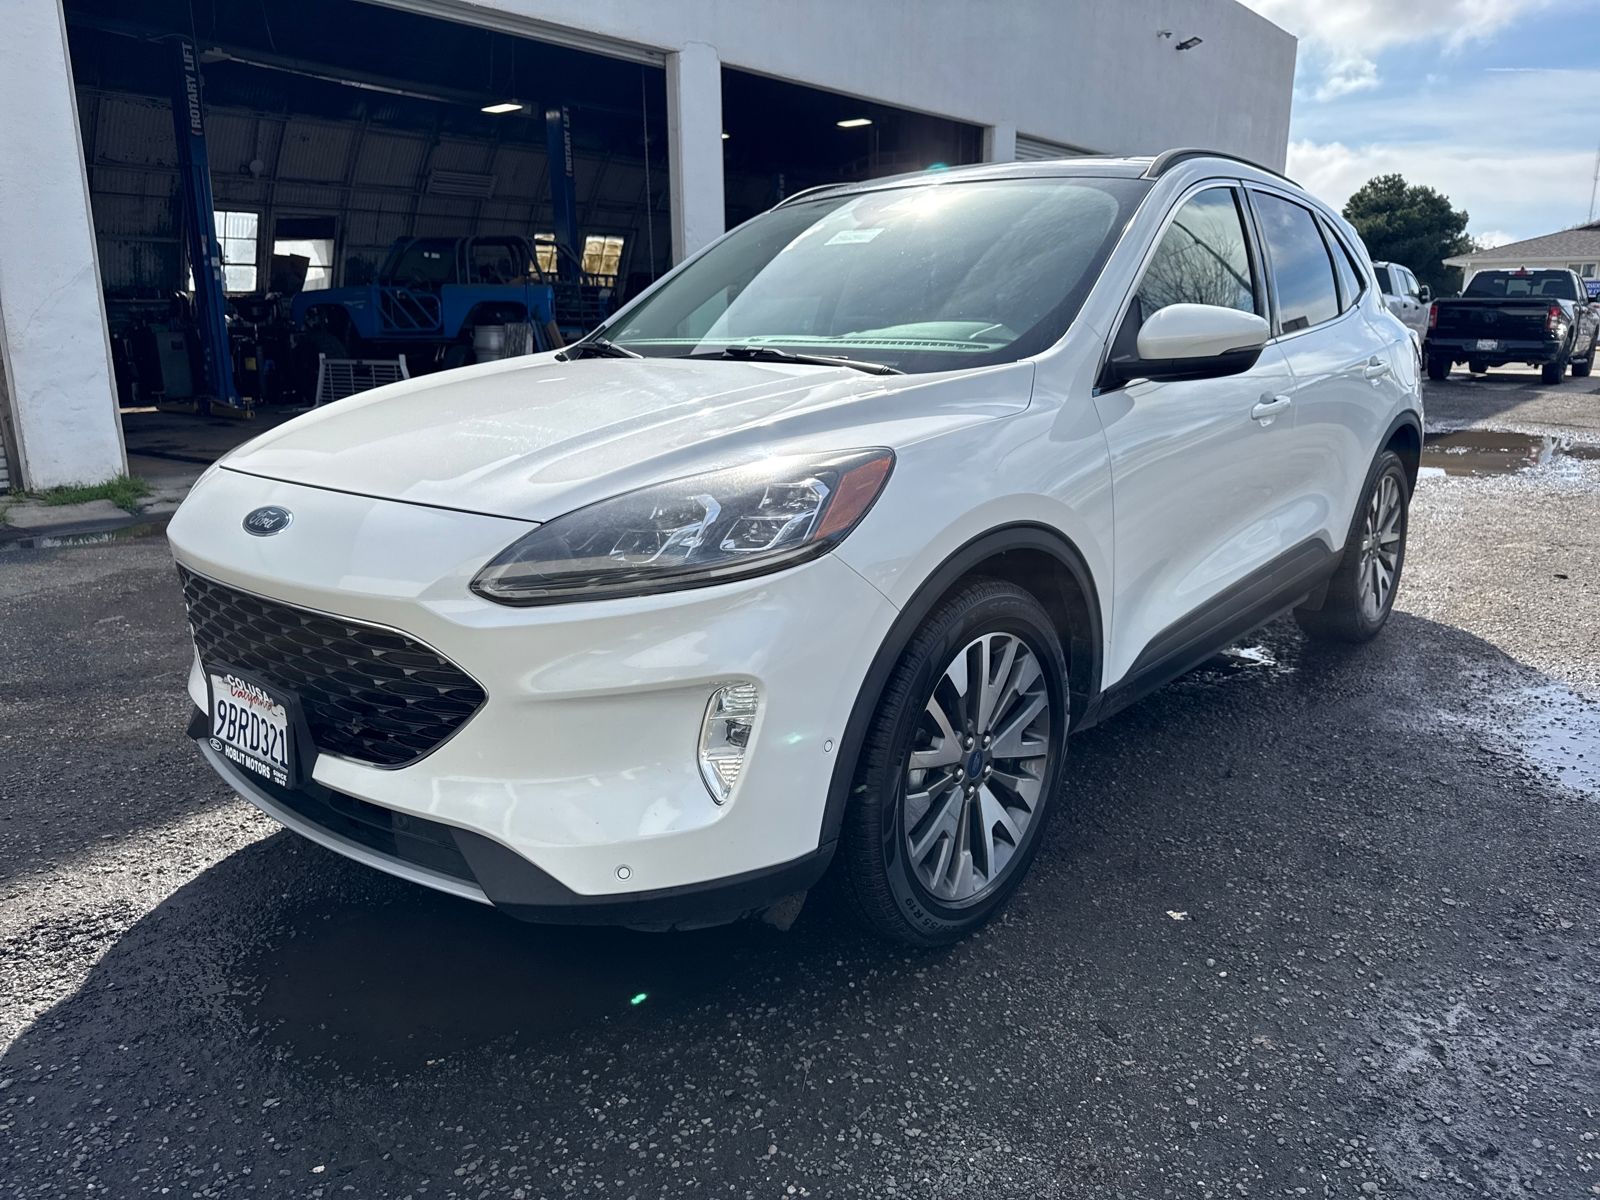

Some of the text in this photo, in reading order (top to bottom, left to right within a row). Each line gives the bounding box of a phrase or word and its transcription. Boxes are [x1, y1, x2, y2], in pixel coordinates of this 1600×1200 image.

[182, 42, 201, 129] ROTARY LIFT
[562, 105, 570, 128] LIFT
[249, 510, 280, 529] Ford
[227, 674, 269, 701] COLUSA
[215, 699, 289, 768] 9BRD321
[225, 744, 246, 765] HOBLIT
[246, 755, 271, 779] MOTORS
